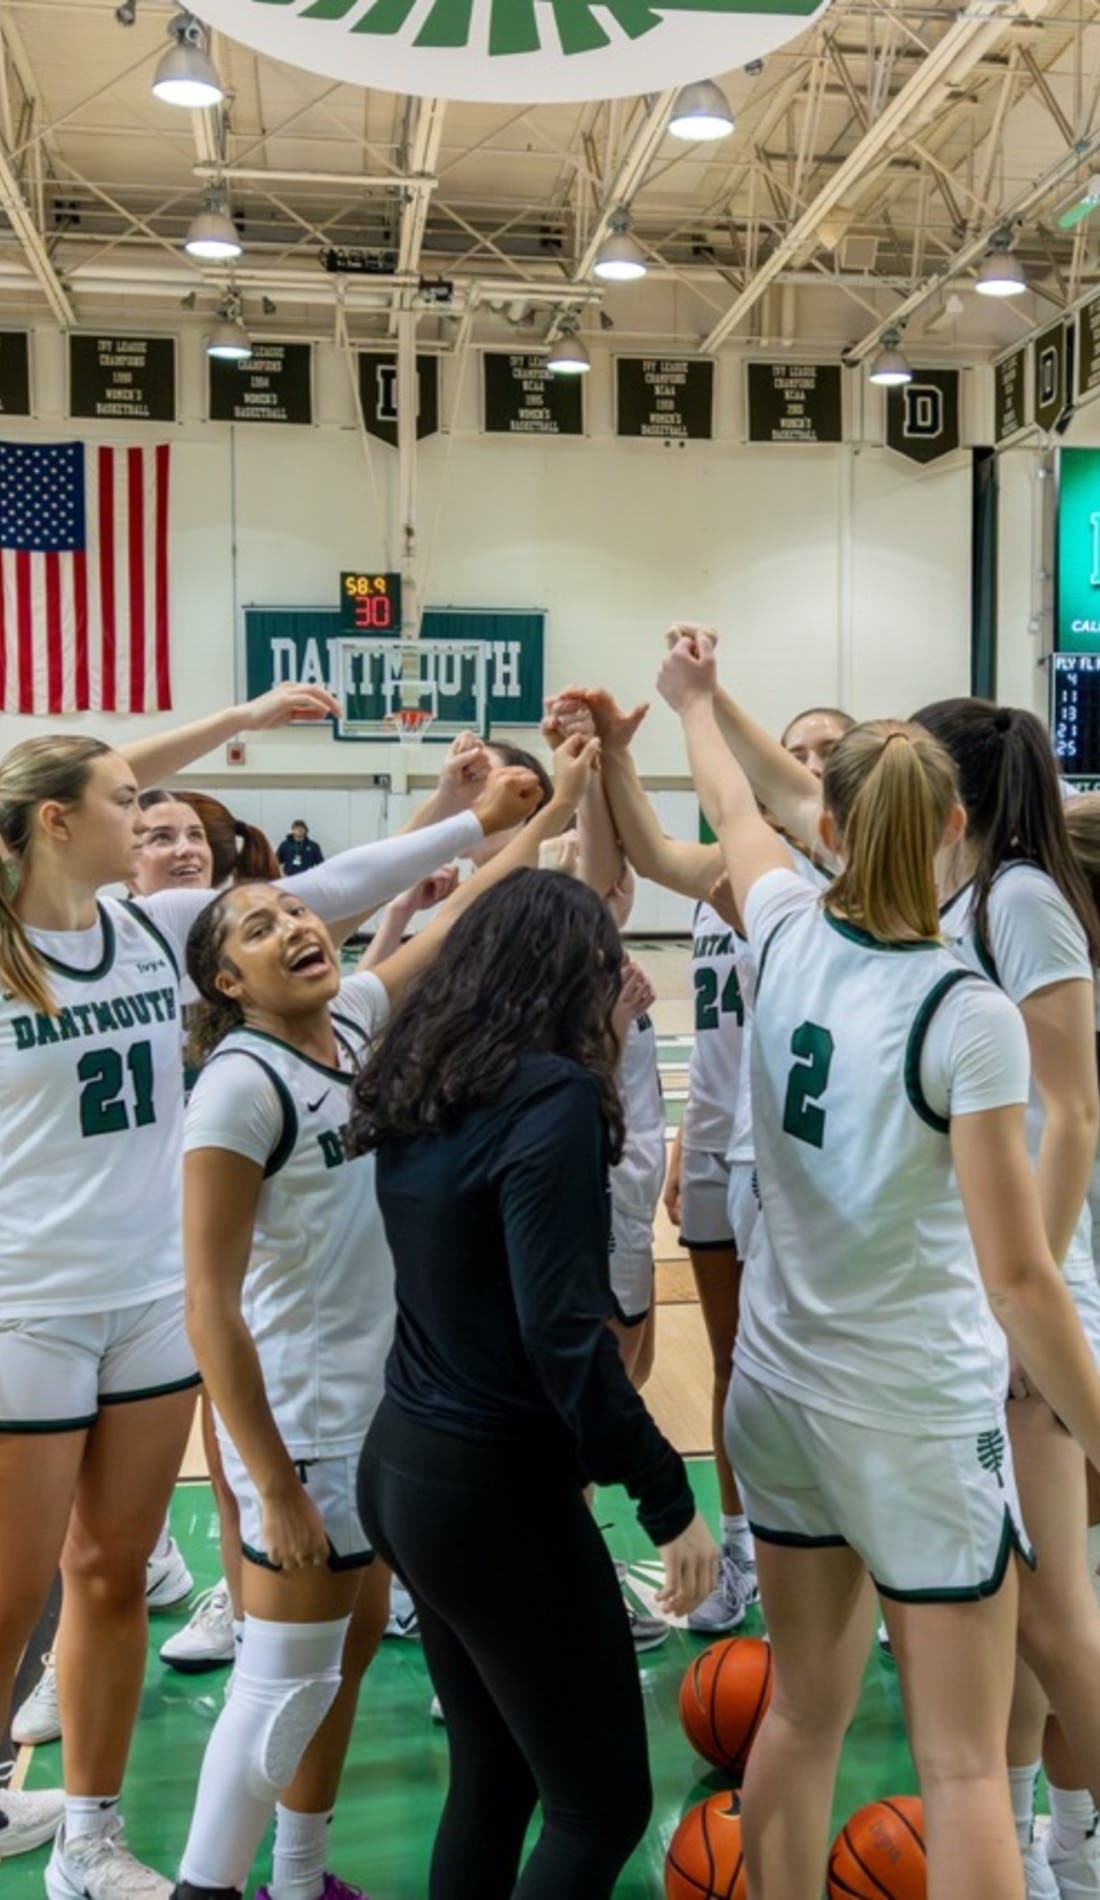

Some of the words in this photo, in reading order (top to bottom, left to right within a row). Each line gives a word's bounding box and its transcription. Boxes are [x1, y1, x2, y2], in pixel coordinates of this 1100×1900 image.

[99, 354, 146, 367] CHAMPIONS
[644, 372, 686, 385] CHAMPIONS
[774, 378, 816, 390] CHAMPIONS
[96, 402, 150, 416] BASKETBALL
[233, 405, 288, 420] BASKETBALL
[903, 384, 943, 439] D
[345, 576, 386, 595] 58.9
[355, 596, 390, 626] 30
[694, 965, 744, 1030] 24
[76, 1040, 156, 1137] 21
[783, 1020, 835, 1150] 2
